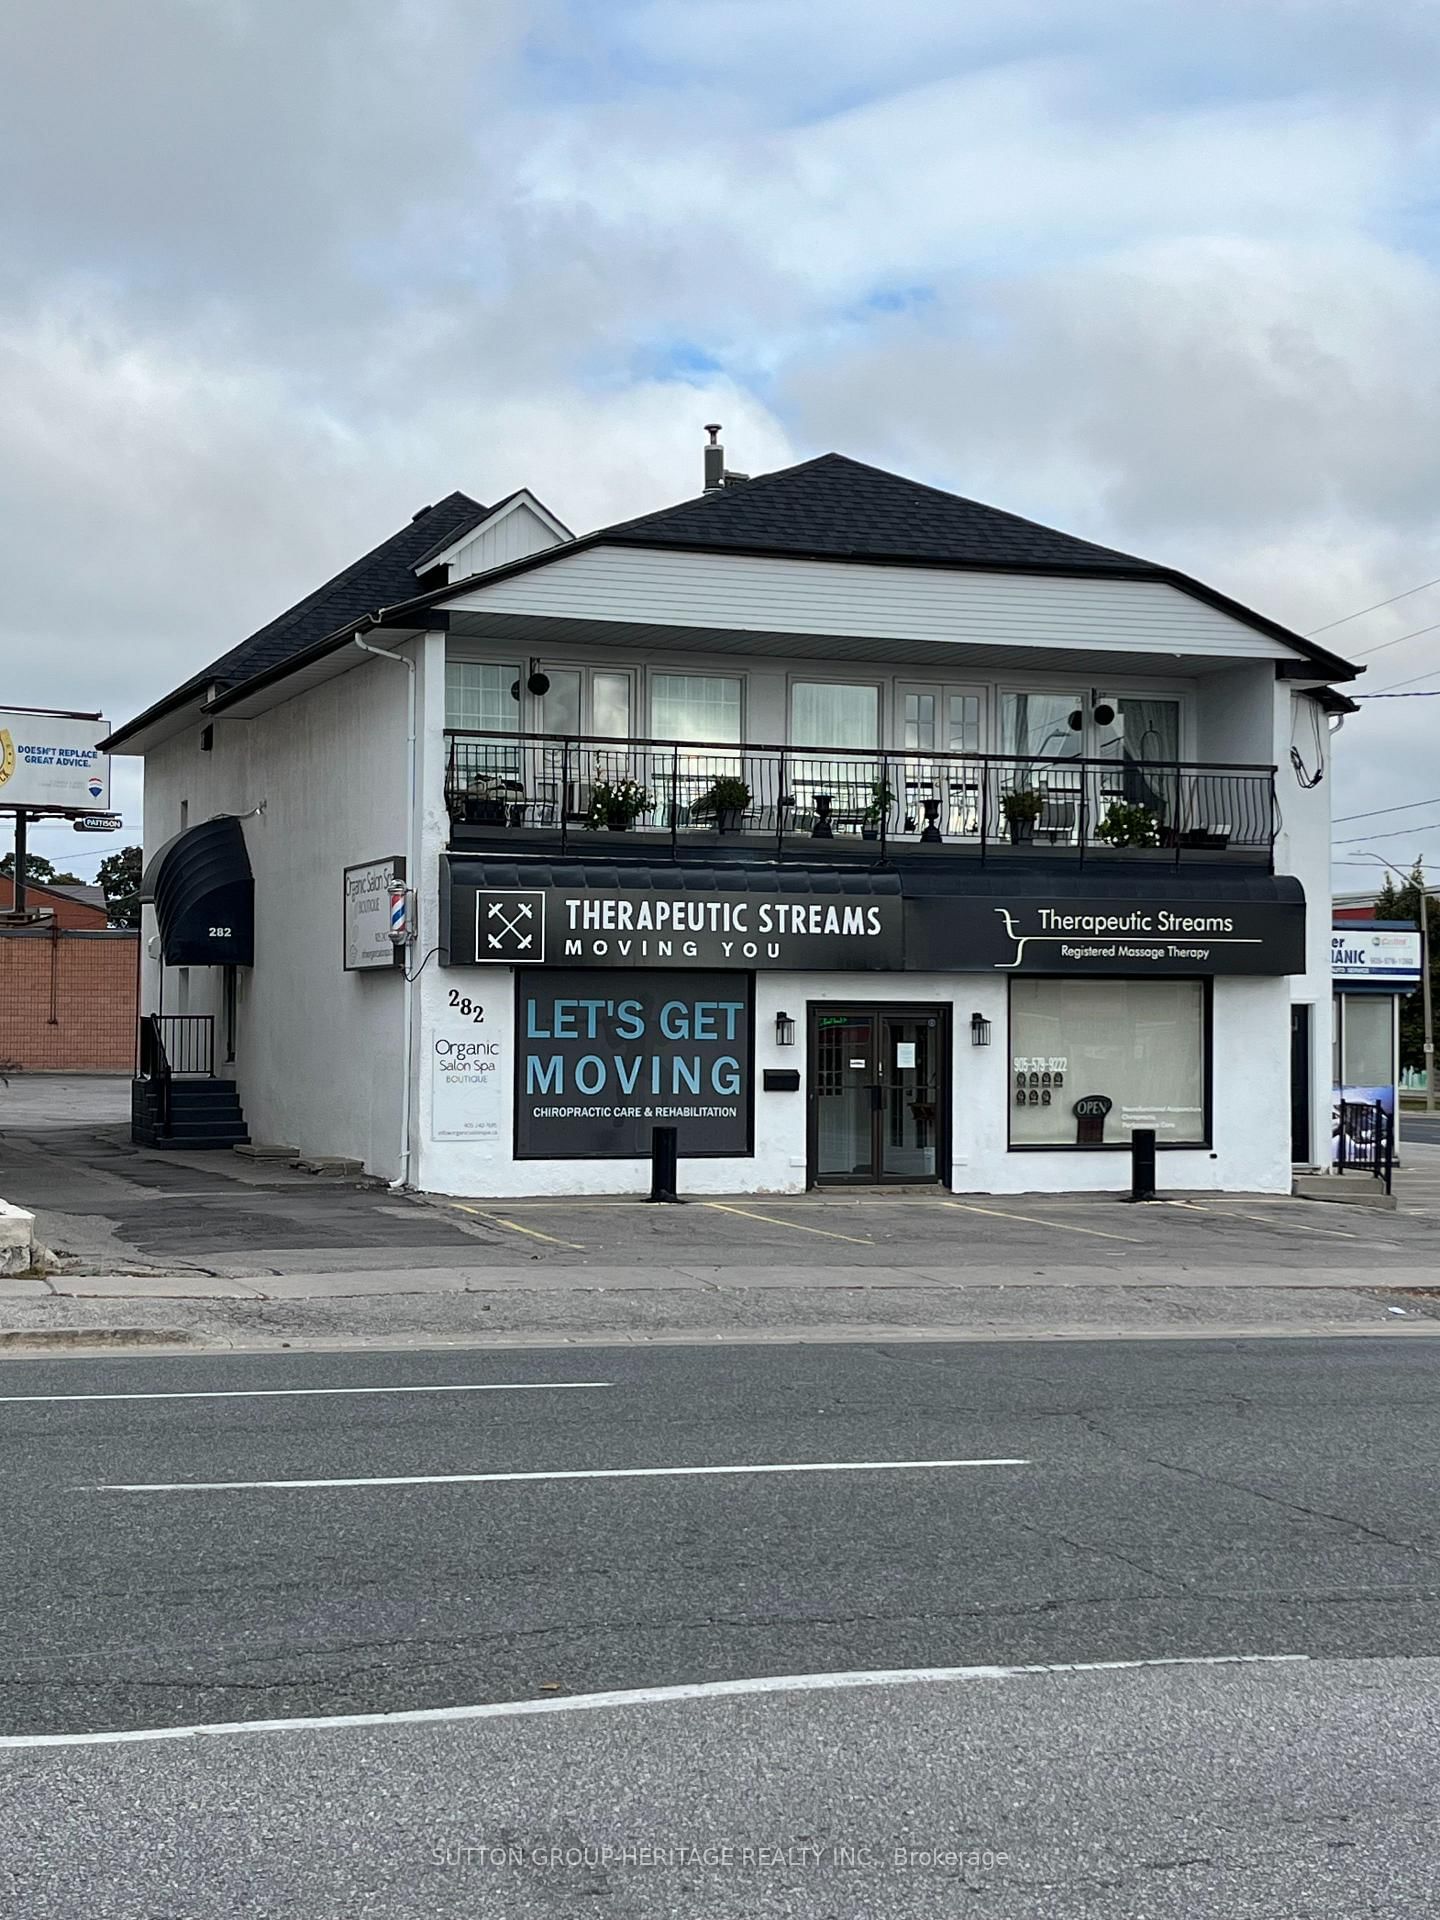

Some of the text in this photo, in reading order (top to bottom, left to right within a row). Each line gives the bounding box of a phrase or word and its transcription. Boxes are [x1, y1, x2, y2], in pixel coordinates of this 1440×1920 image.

[17, 745, 98, 759] DOESN'T REPLACE
[24, 755, 91, 768] GREAT ADVICE.
[86, 818, 121, 828] PATTISON
[345, 877, 367, 903] Organic
[366, 871, 383, 893] Salon
[565, 899, 882, 937] THERAPEUTIC STREAMS
[1037, 908, 1233, 935] Therapeutic Streams
[208, 927, 232, 937] 282
[564, 939, 781, 959] MOVING YOU
[1060, 945, 1210, 960] Registered Massage Therapy
[448, 989, 484, 1023] 282
[527, 999, 744, 1040] LET'S GET
[435, 1039, 500, 1060] Organic
[439, 1059, 496, 1074] Salon Spa
[446, 1075, 488, 1083] BOUTIQUE
[526, 1055, 741, 1095] MOVING
[533, 1107, 737, 1117] CHIROPRACTIC CARE & REHABILITATION
[1077, 1101, 1107, 1115] OPEN
